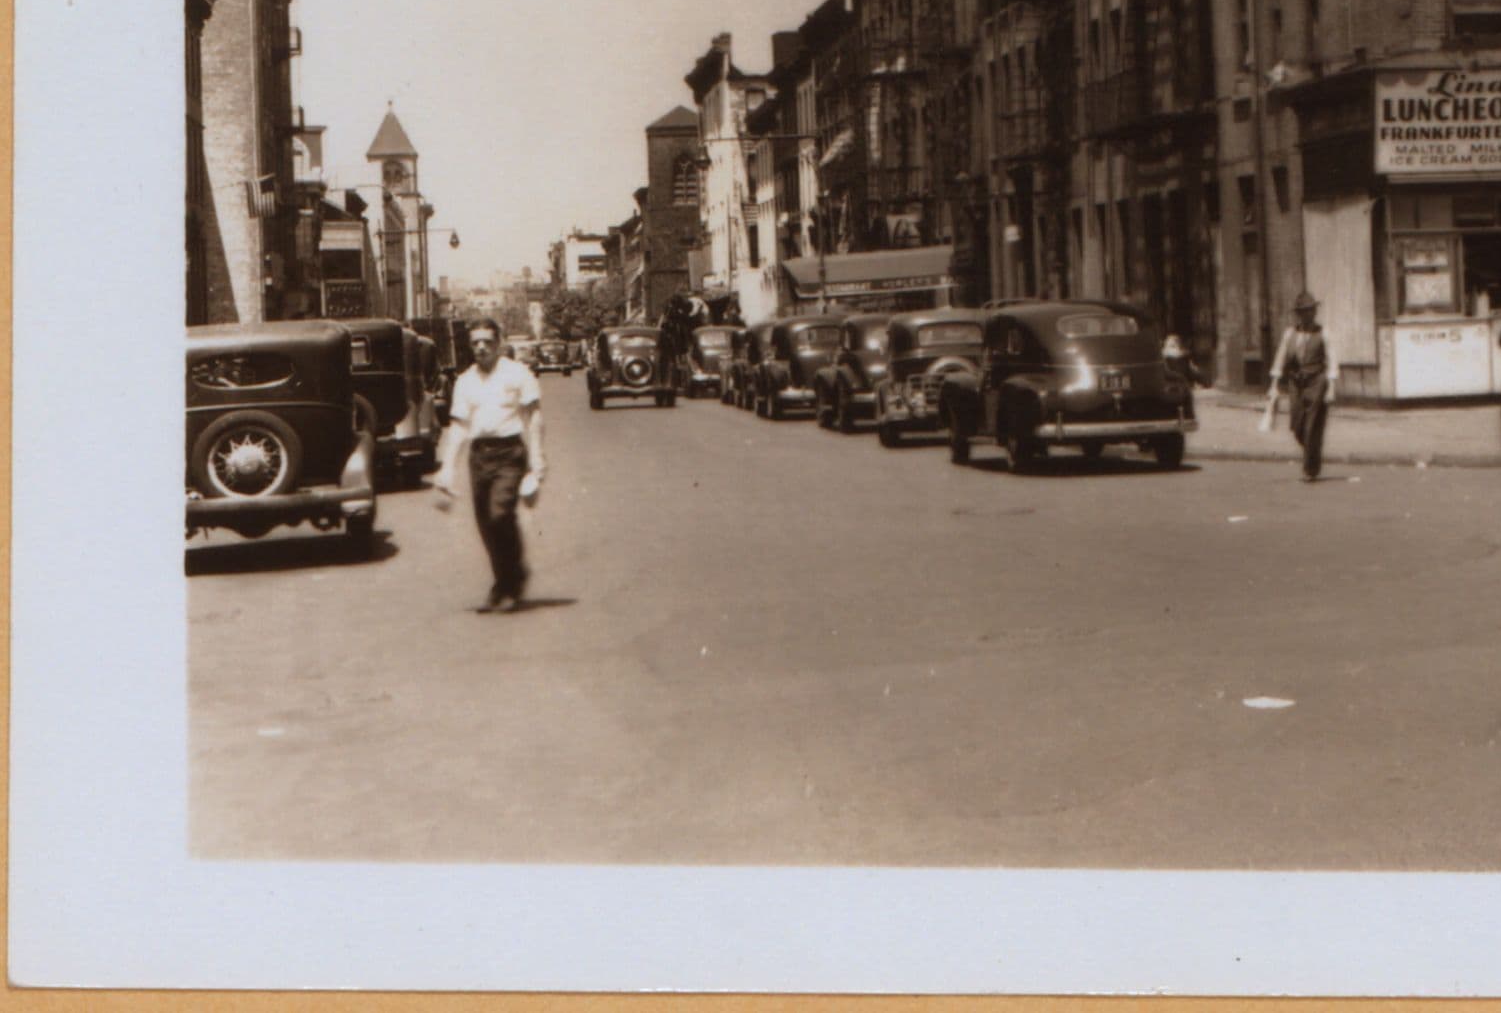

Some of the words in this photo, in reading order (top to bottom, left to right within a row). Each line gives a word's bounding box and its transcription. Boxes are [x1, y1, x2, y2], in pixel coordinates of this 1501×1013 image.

[1395, 143, 1456, 155] MALTED
[1390, 155, 1415, 165] ICE
[1420, 154, 1472, 165] CREAM
